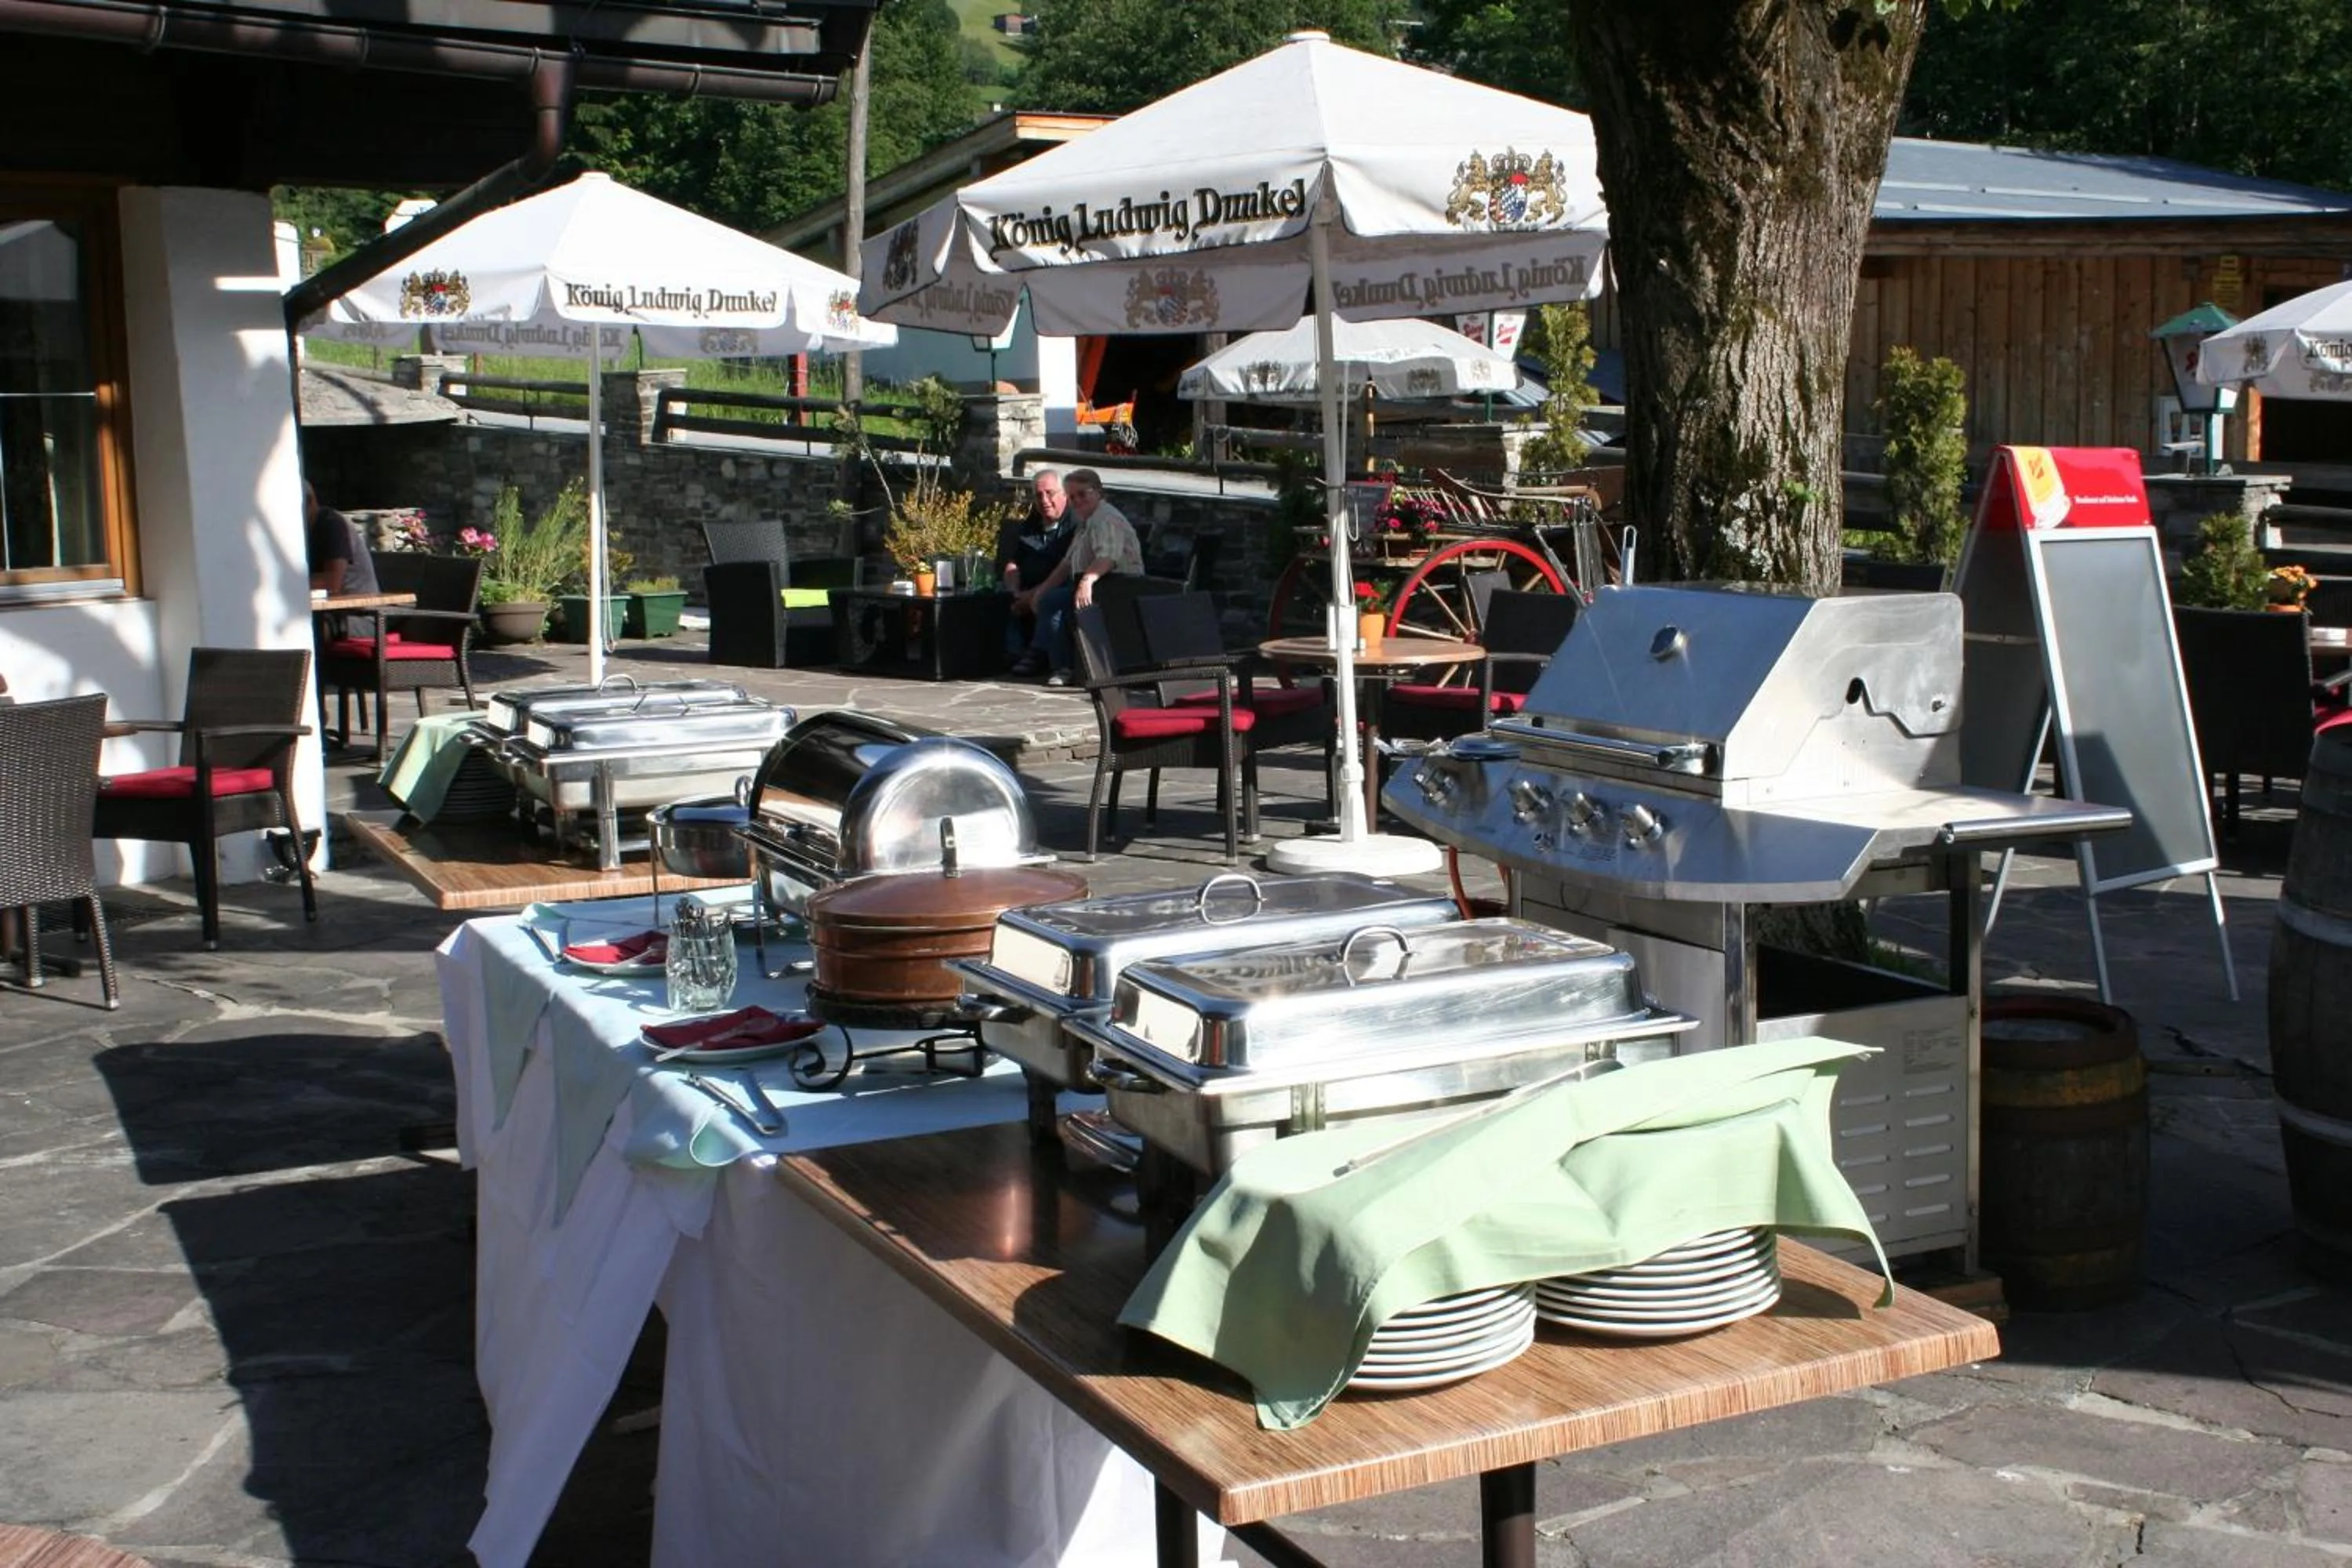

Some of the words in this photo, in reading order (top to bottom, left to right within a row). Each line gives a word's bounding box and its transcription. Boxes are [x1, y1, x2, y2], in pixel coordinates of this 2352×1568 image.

[987, 205, 1073, 262] König
[1073, 191, 1189, 255] Ludwig
[1189, 178, 1305, 239] Dunkel
[564, 282, 624, 313] König
[625, 285, 702, 318] Ludwig
[702, 289, 777, 318] Dunkel
